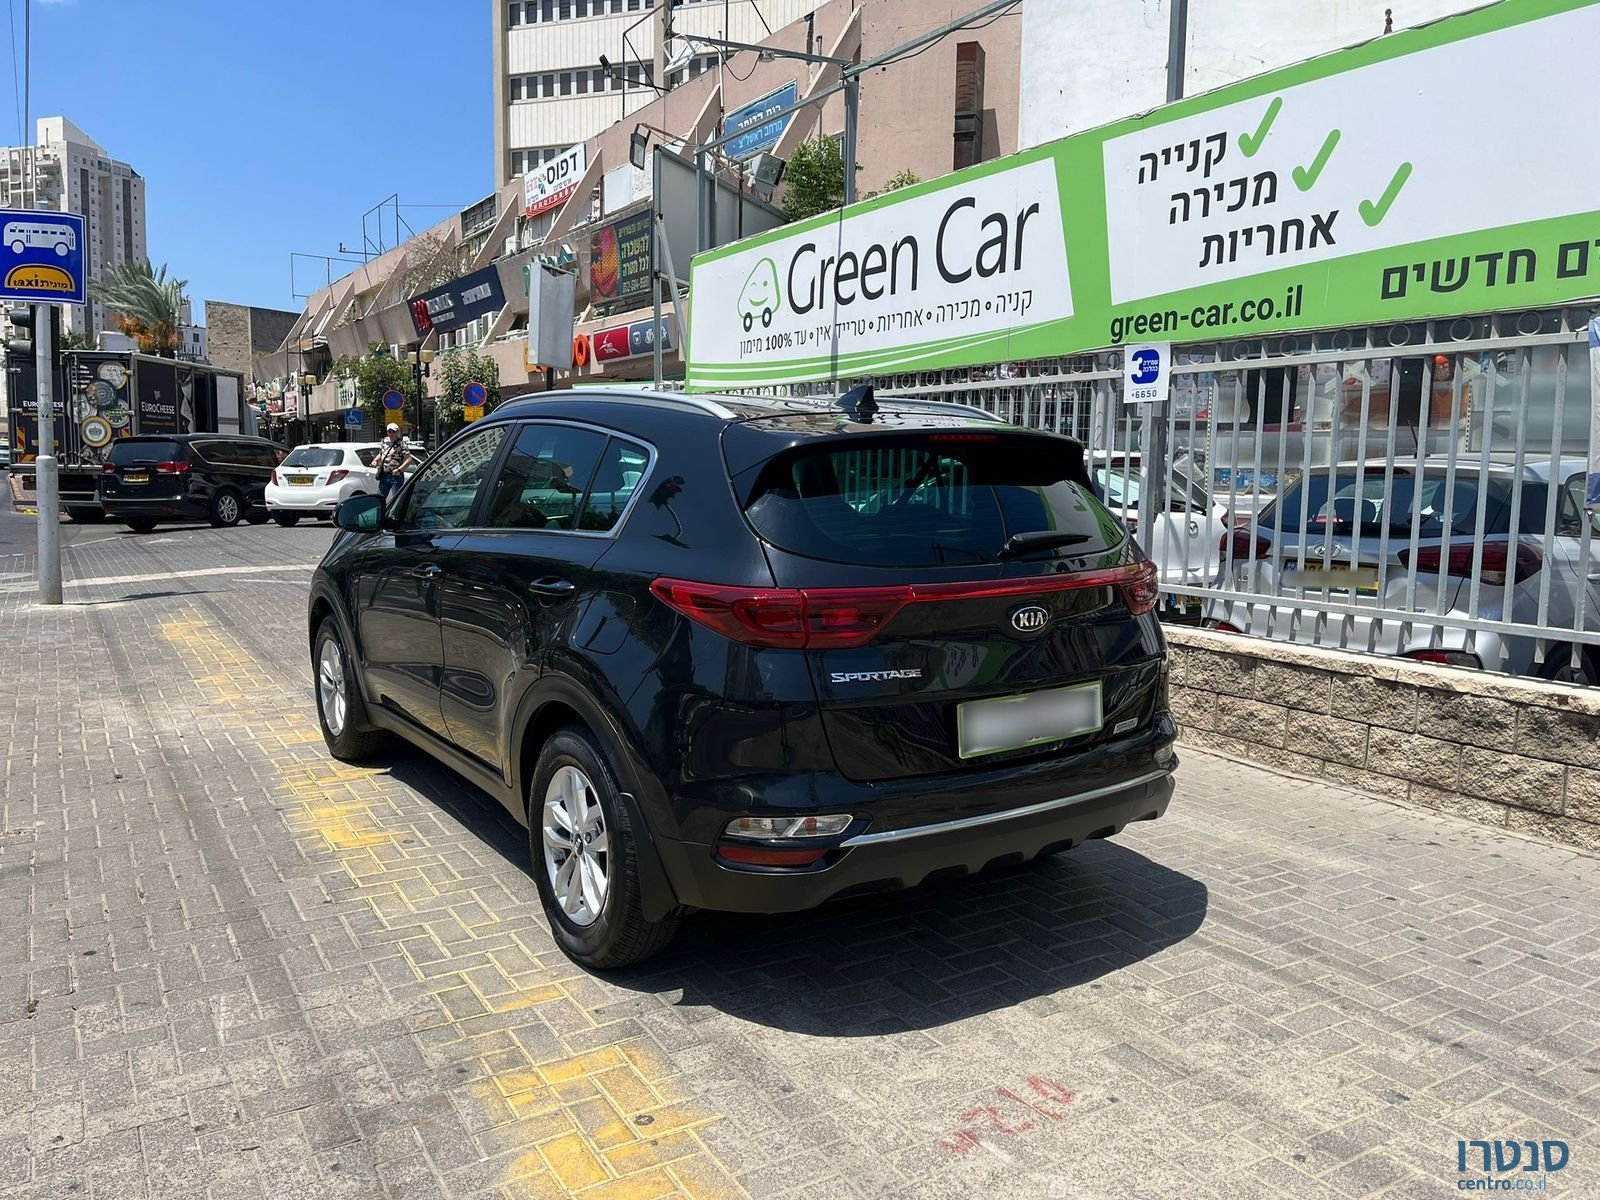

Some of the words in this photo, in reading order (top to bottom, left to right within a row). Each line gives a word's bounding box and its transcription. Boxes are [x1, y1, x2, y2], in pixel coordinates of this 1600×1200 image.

[546, 151, 578, 185] דפוס
[1138, 131, 1227, 185] קנייה
[1168, 171, 1278, 225] מכירה
[1198, 210, 1339, 268] אחריות
[787, 233, 918, 316] Green
[935, 196, 1039, 285] Car
[13, 273, 39, 287] taxi
[39, 279, 68, 289] מונית
[1381, 248, 1536, 300] חדשים
[936, 299, 981, 325] מכירה
[995, 289, 1033, 317] קניה
[1111, 284, 1303, 344] green-car.co.il
[876, 308, 923, 333] אחריות
[739, 337, 762, 359] מימון
[765, 330, 793, 351] 100%
[794, 328, 807, 347] עד
[1018, 610, 1044, 629] KIA
[830, 668, 922, 684] SPORTAGE
